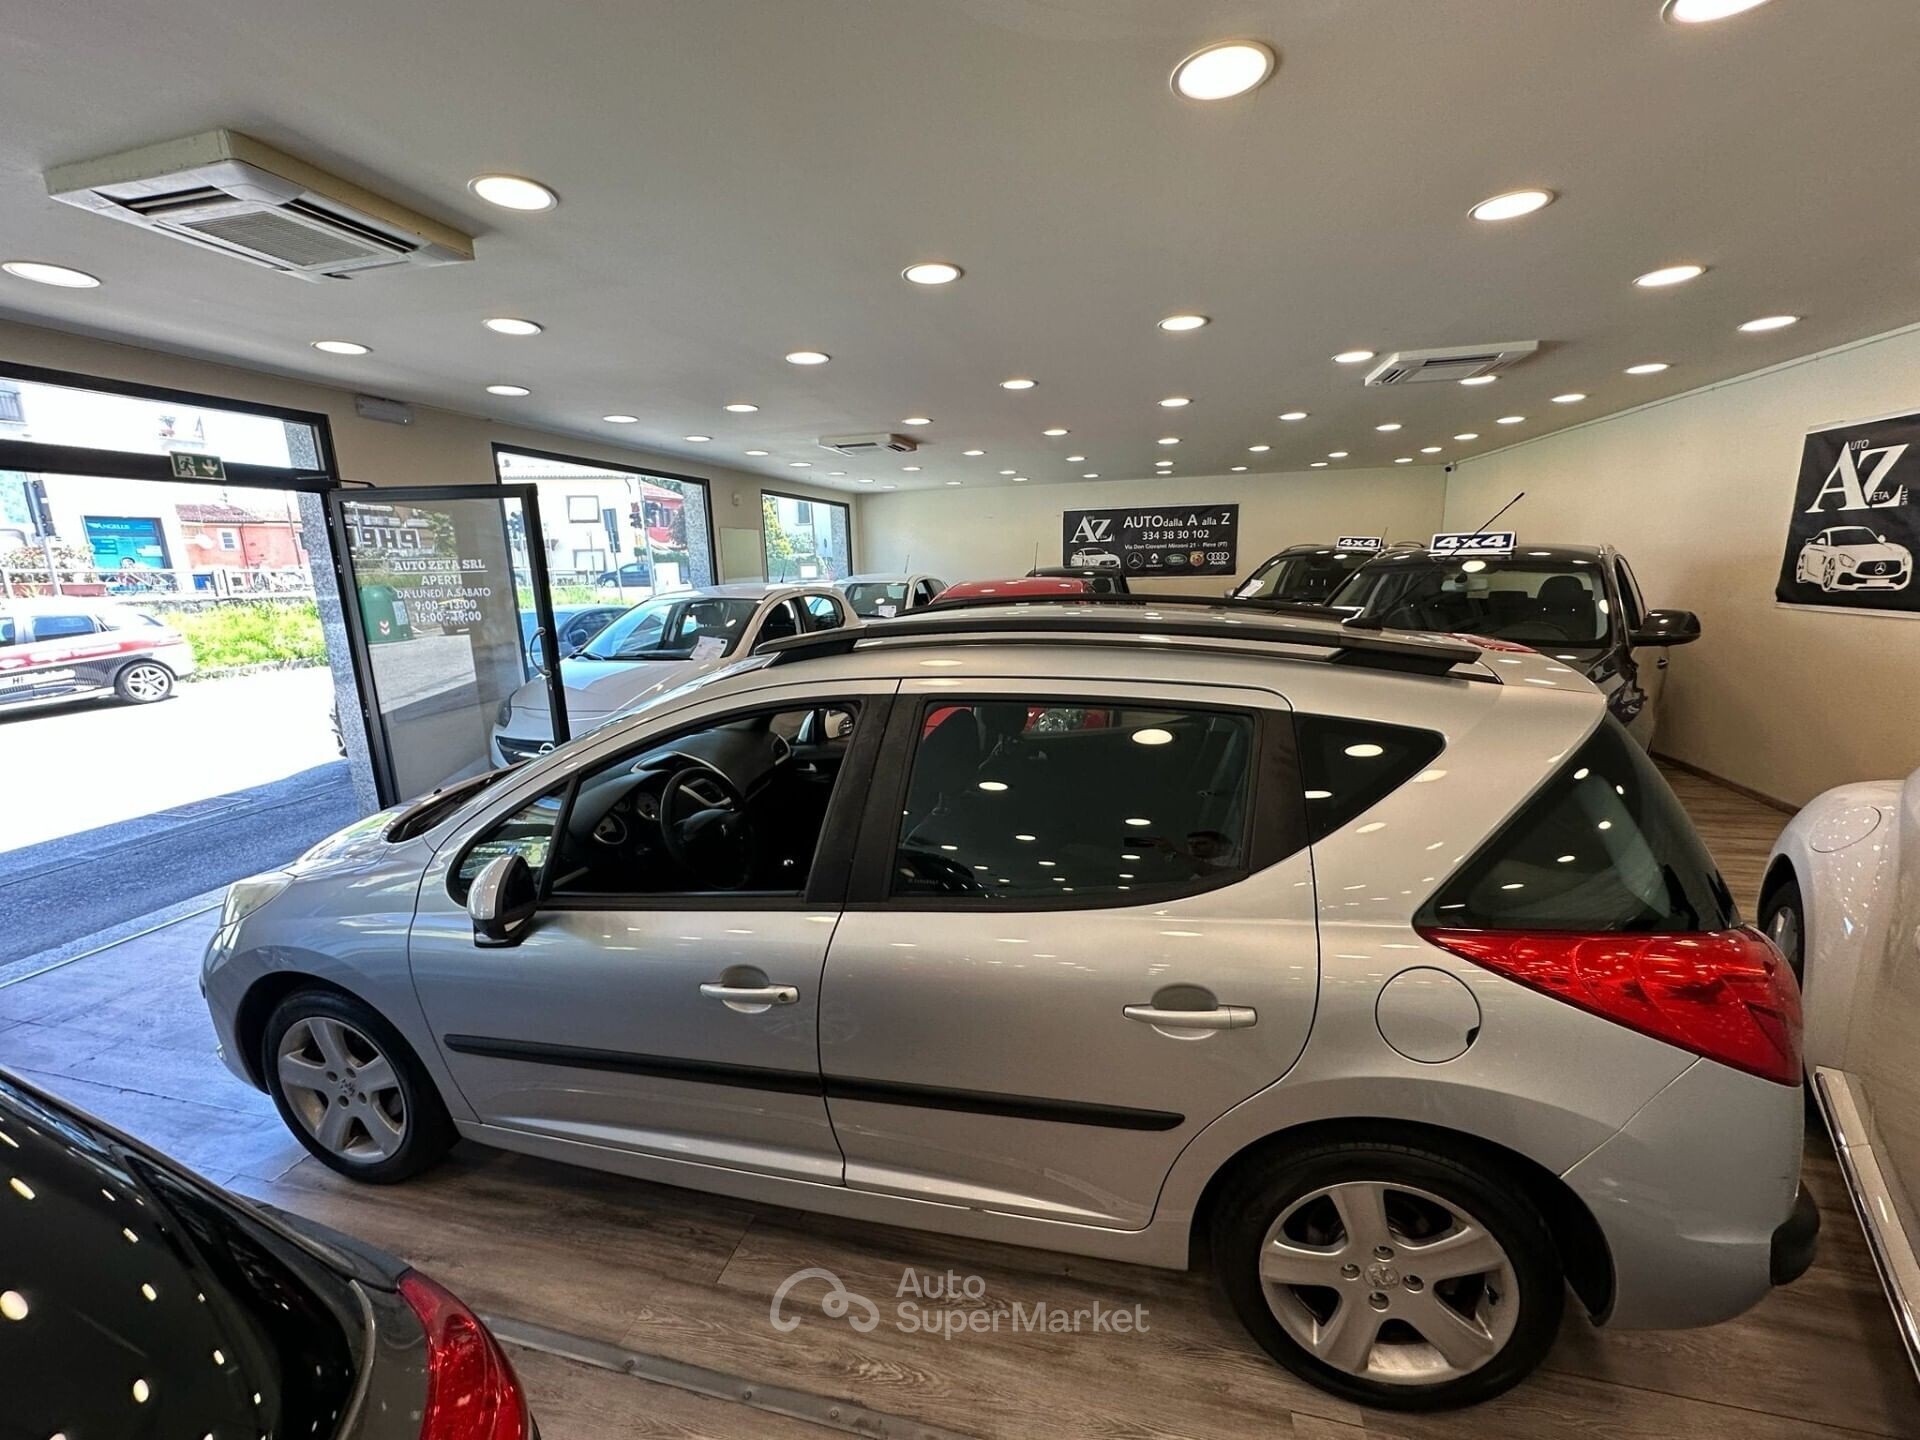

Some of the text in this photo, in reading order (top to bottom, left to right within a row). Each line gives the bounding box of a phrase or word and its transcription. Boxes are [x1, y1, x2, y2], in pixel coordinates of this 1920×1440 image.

[1187, 514, 1198, 526] A
[1202, 517, 1217, 526] alla
[1221, 513, 1231, 525] Z
[1142, 530, 1209, 540] 334 38 30 102
[1339, 538, 1377, 547] 4x4
[1436, 535, 1507, 549] 4x4
[394, 559, 485, 571] AUTO ZETA SRL
[421, 574, 463, 585] APERTI
[397, 590, 411, 599] DA
[455, 587, 491, 597] SABATO
[415, 600, 438, 611] 9:00
[449, 599, 477, 610] 13:00
[415, 611, 443, 623] 15:00
